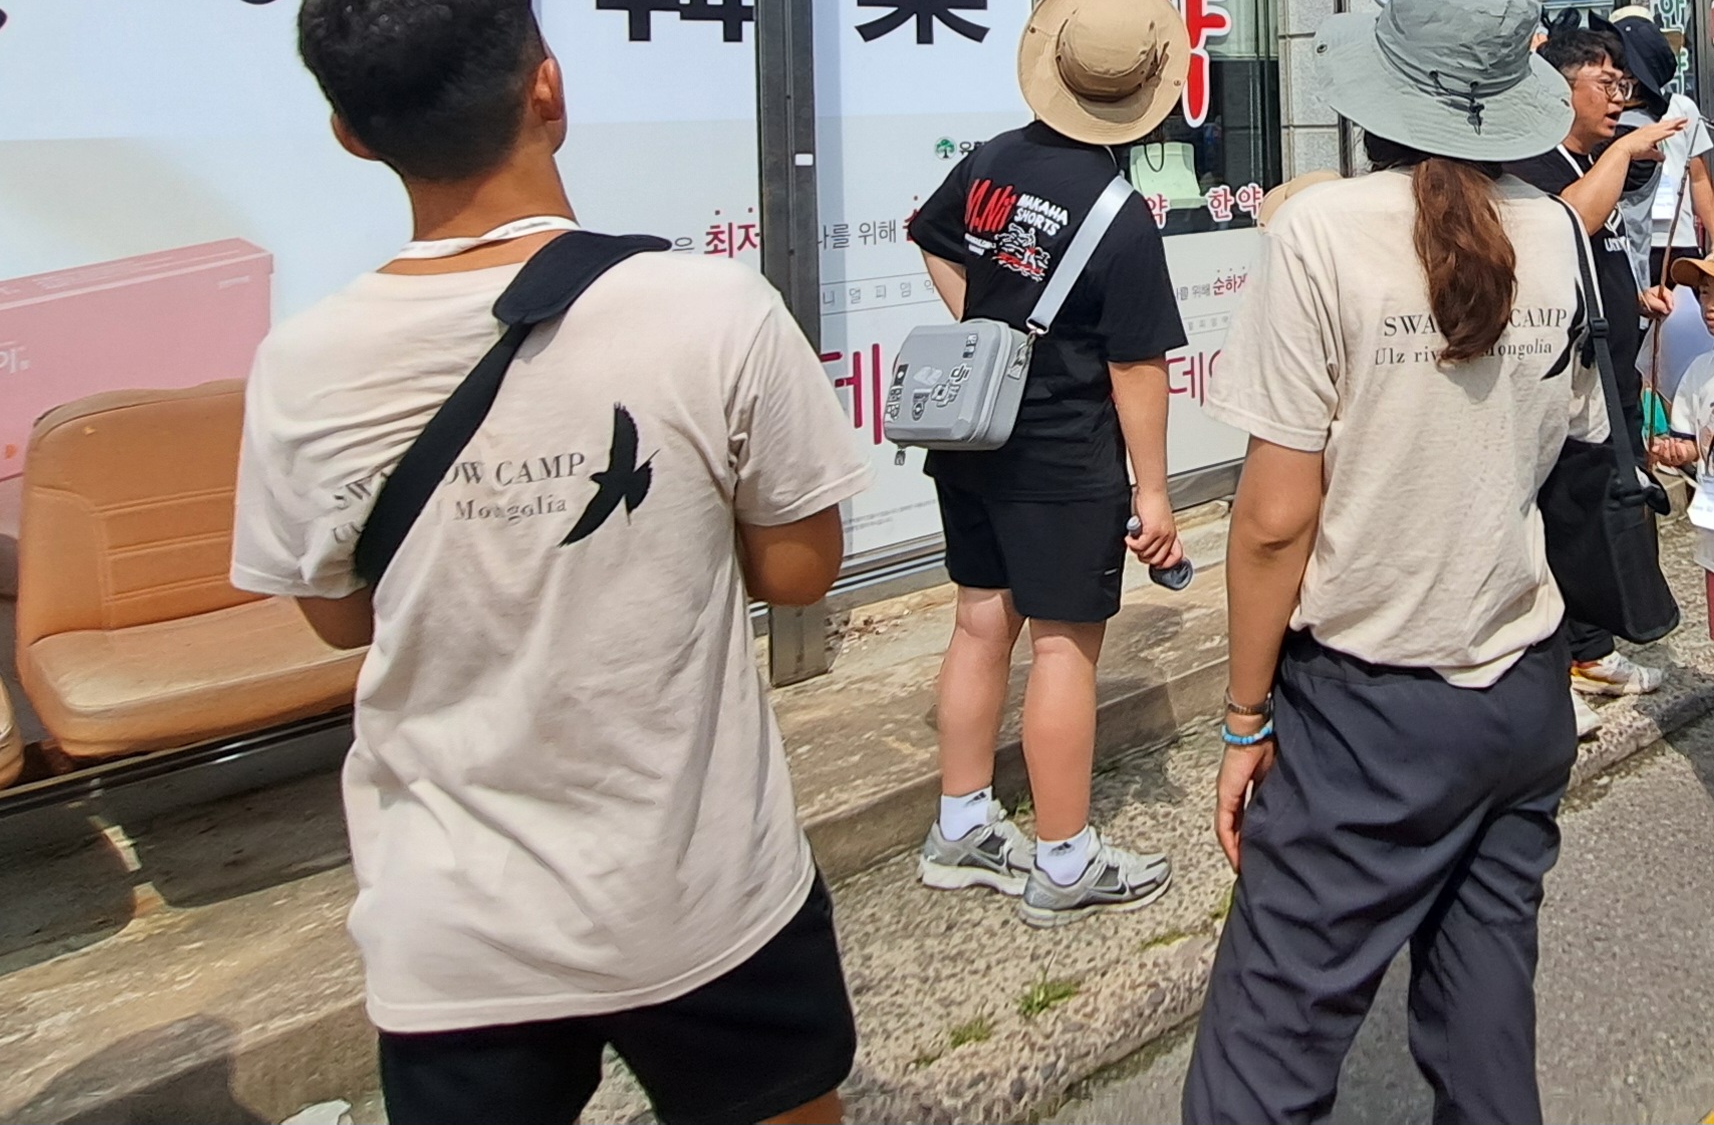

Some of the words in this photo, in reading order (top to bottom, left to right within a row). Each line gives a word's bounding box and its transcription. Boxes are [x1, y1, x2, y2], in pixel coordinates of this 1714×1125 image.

[1017, 193, 1068, 226] MAKAHA
[1208, 184, 1264, 221] 한약
[857, 221, 897, 245] 위해
[1013, 207, 1060, 236] SHORTS
[1509, 308, 1568, 329] CAMP
[1375, 346, 1406, 365] Ulz
[496, 452, 586, 488] CAMP
